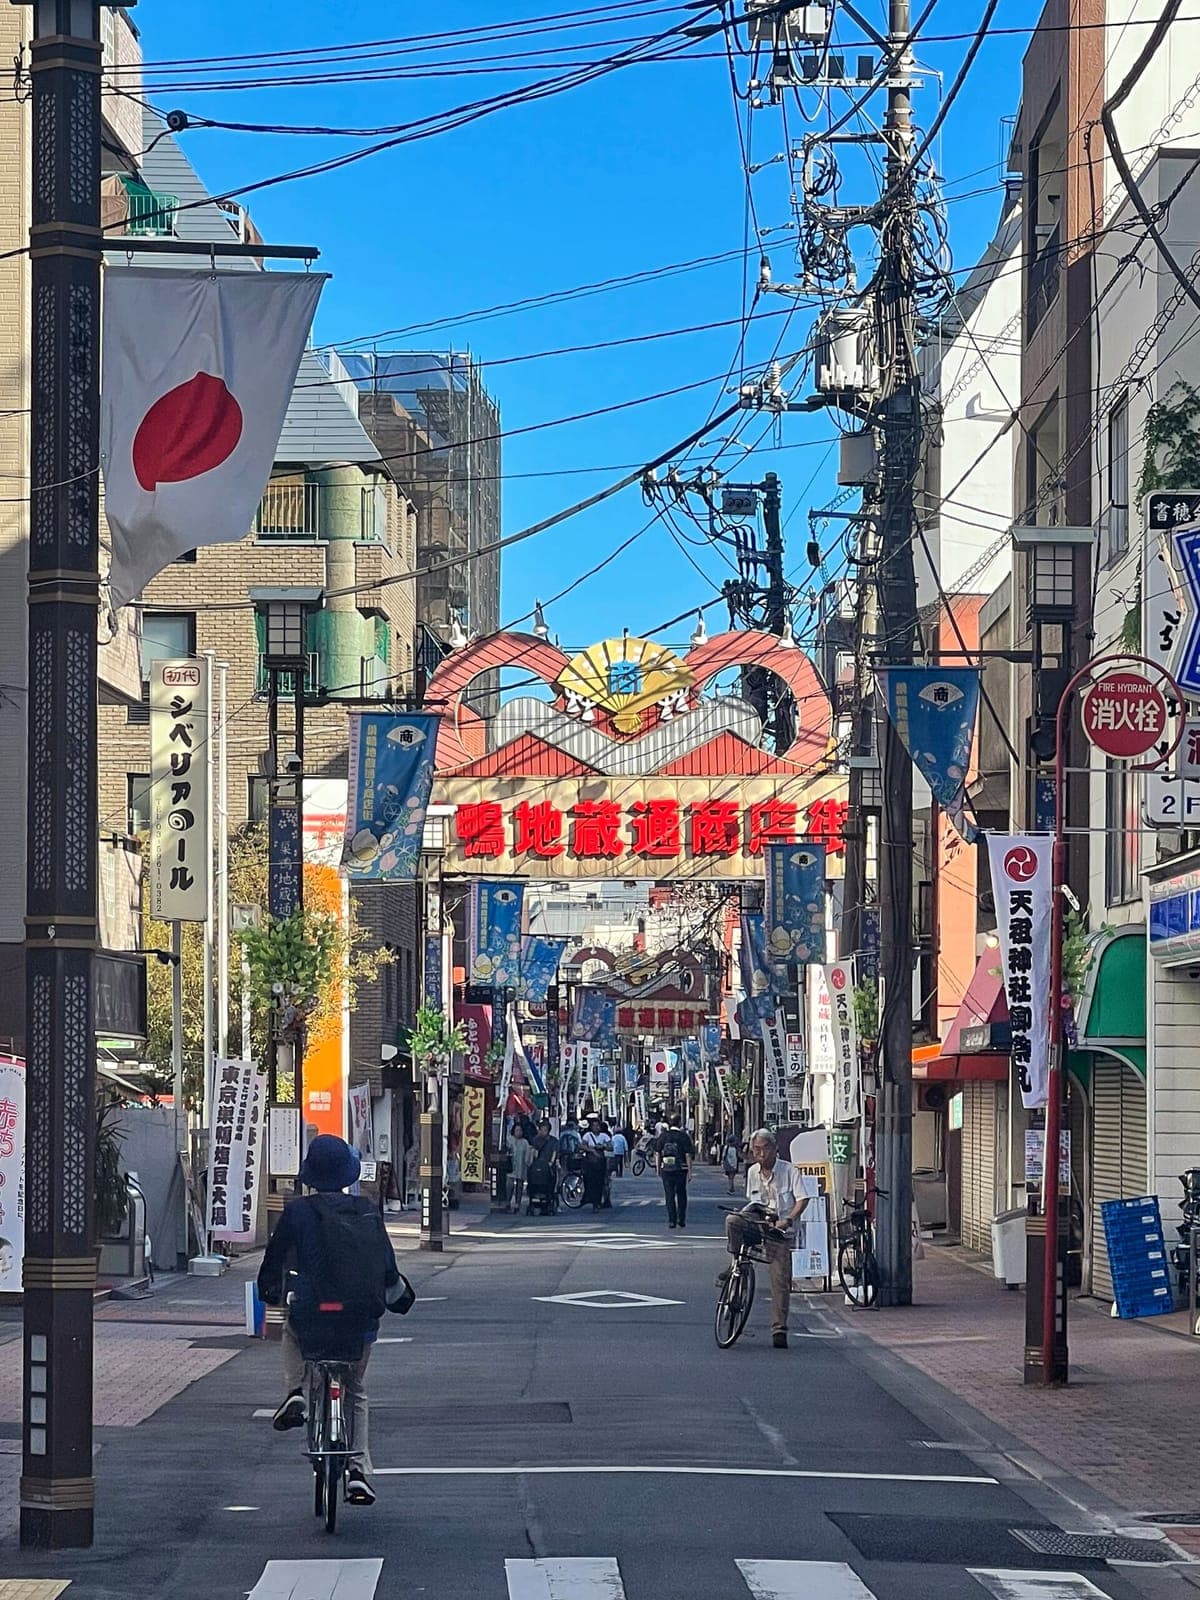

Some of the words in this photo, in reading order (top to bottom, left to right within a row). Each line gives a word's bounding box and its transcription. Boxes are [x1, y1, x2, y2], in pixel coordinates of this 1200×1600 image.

[166, 670, 196, 682] 初代
[934, 687, 949, 702] 商
[1098, 682, 1116, 693] FIRE
[1117, 683, 1153, 694] HYDRANT
[1091, 697, 1160, 732] 消火栓
[400, 730, 413, 743] 商
[168, 695, 194, 891] シベリアール
